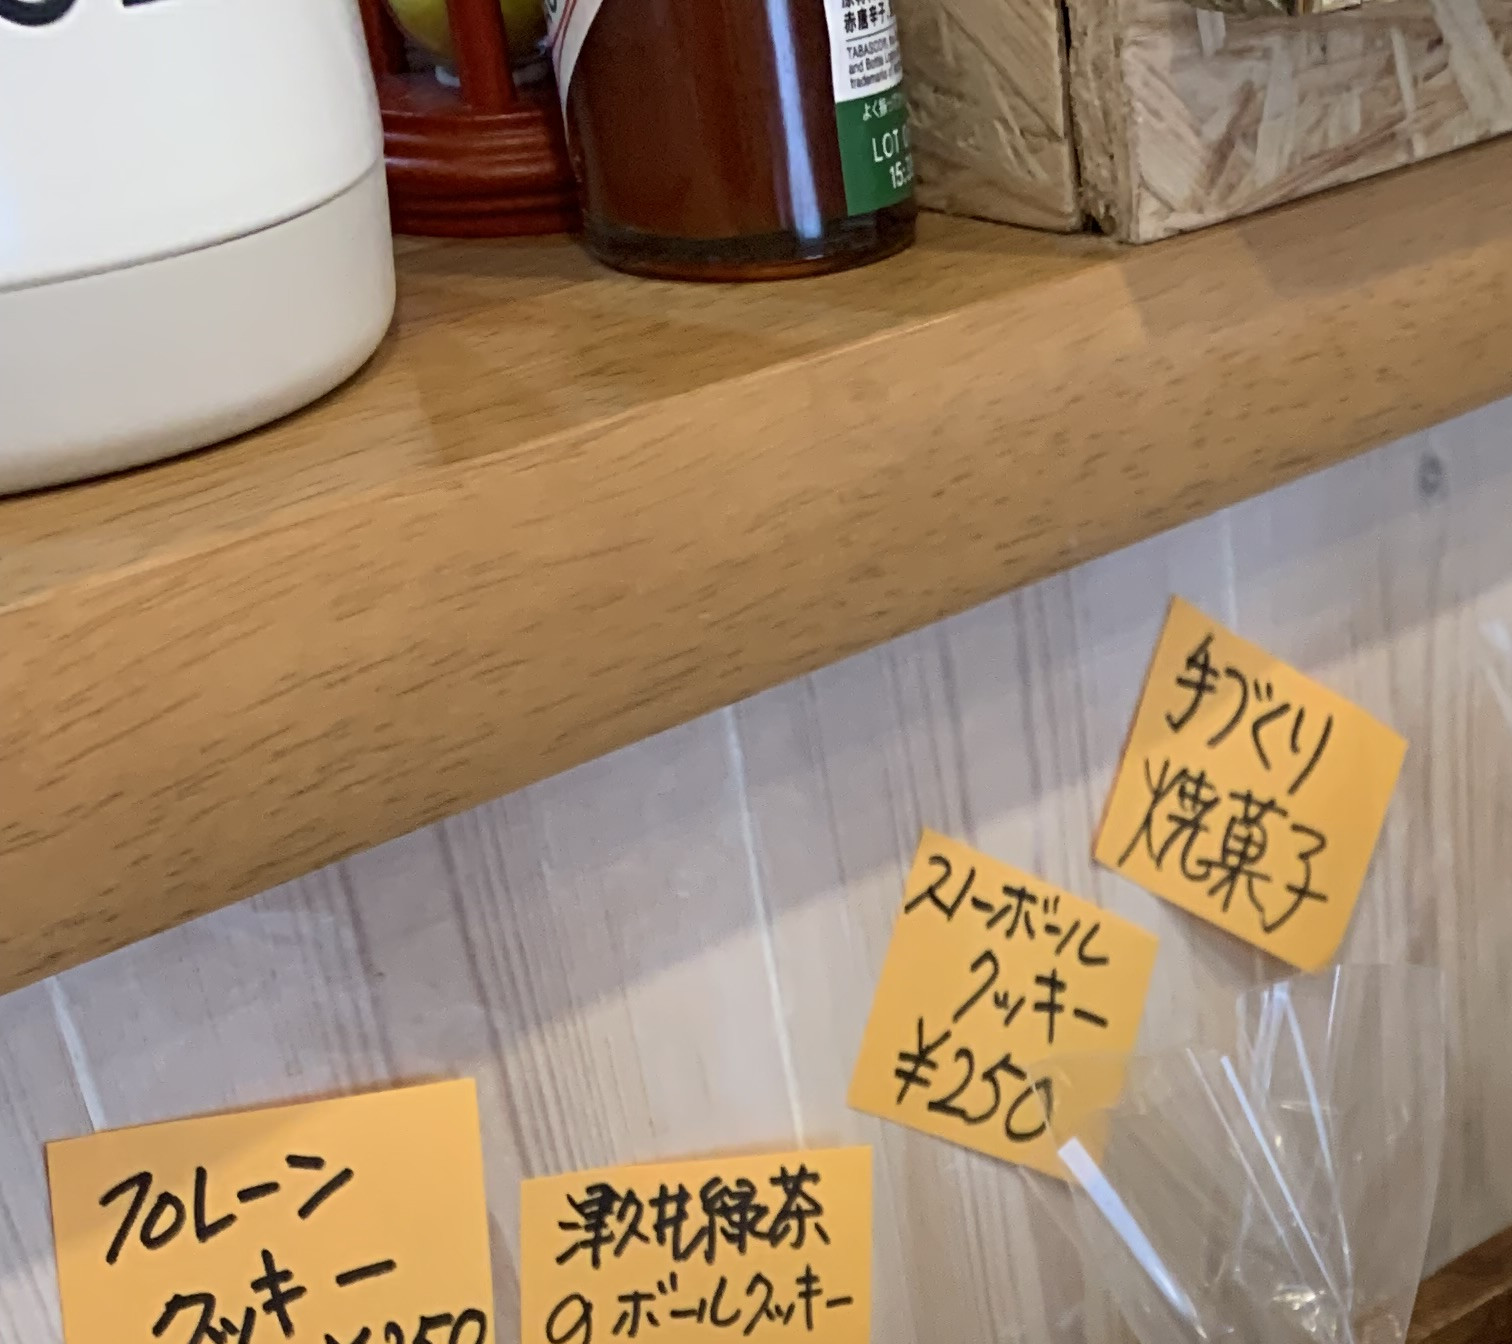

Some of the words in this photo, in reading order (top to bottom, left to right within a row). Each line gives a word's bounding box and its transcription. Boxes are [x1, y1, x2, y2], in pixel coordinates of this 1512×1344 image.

[1164, 633, 1333, 796] 手づくり
[1117, 758, 1328, 933] 焼菓子
[953, 949, 1109, 1045] クッキー
[895, 1015, 1053, 1142] ¥250
[556, 1163, 830, 1269] 津久井緑茶
